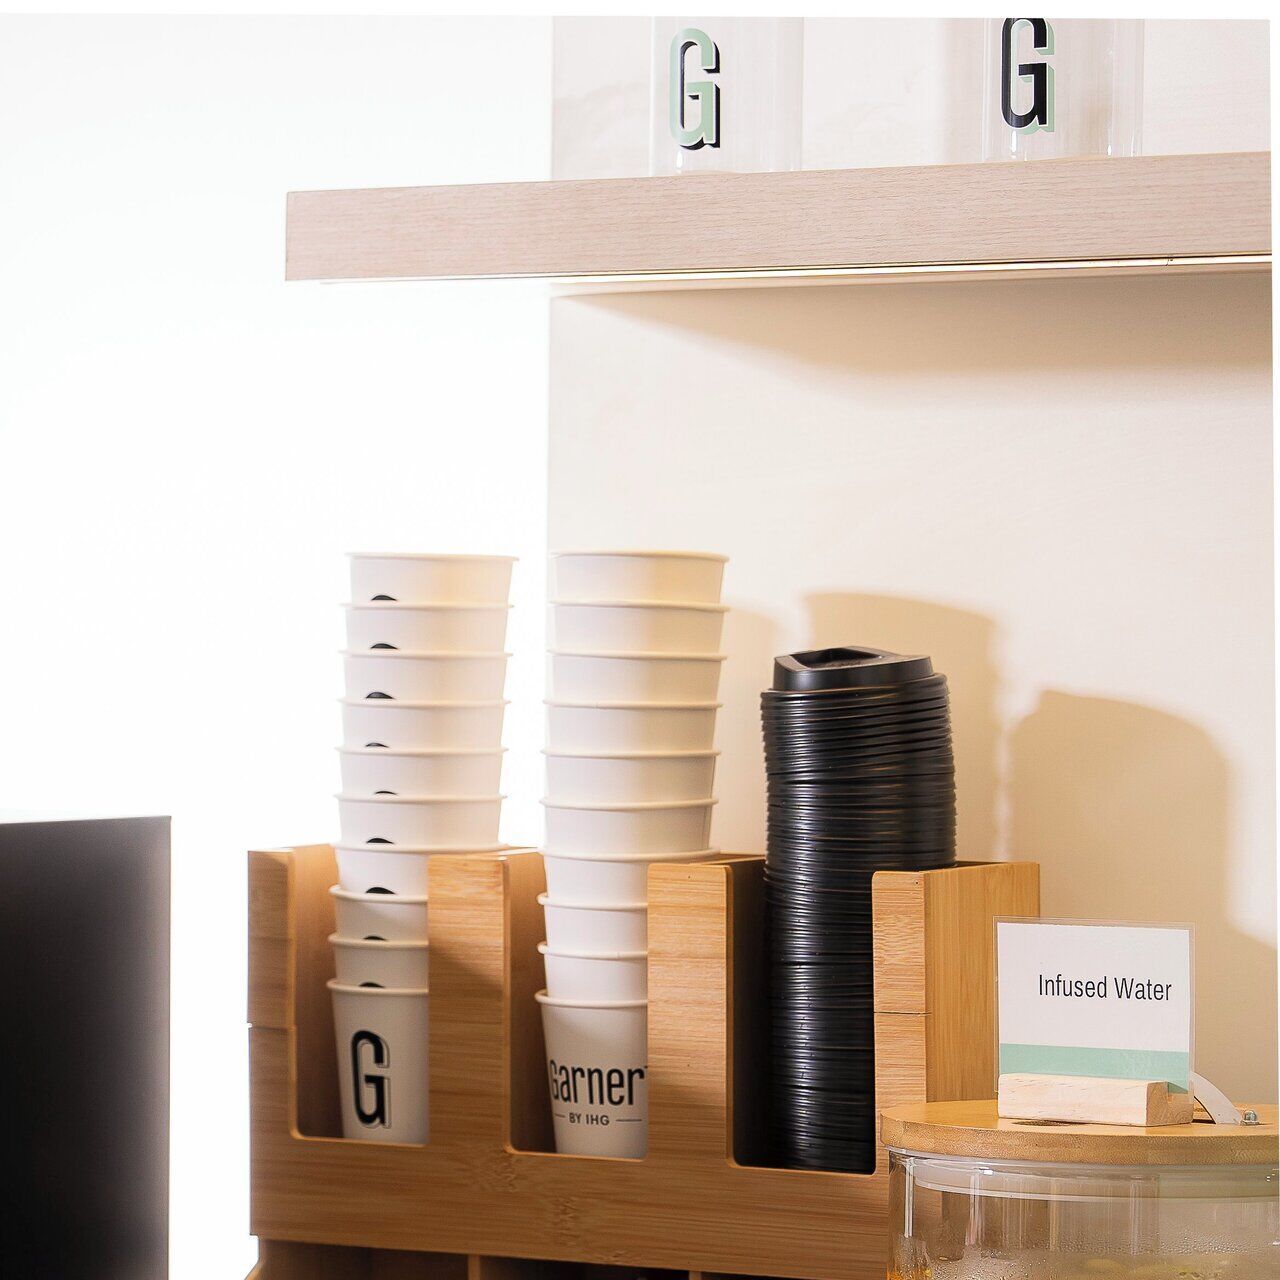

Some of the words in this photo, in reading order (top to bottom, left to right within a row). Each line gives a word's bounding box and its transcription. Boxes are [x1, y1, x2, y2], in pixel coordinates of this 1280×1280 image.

[669, 27, 720, 150] G
[1001, 18, 1054, 135] G
[1039, 974, 1107, 998] Infused
[1114, 977, 1172, 1001] Water
[351, 1030, 391, 1129] G
[549, 1060, 645, 1106] Garner
[569, 1113, 581, 1123] BY
[586, 1114, 610, 1126] IHG
